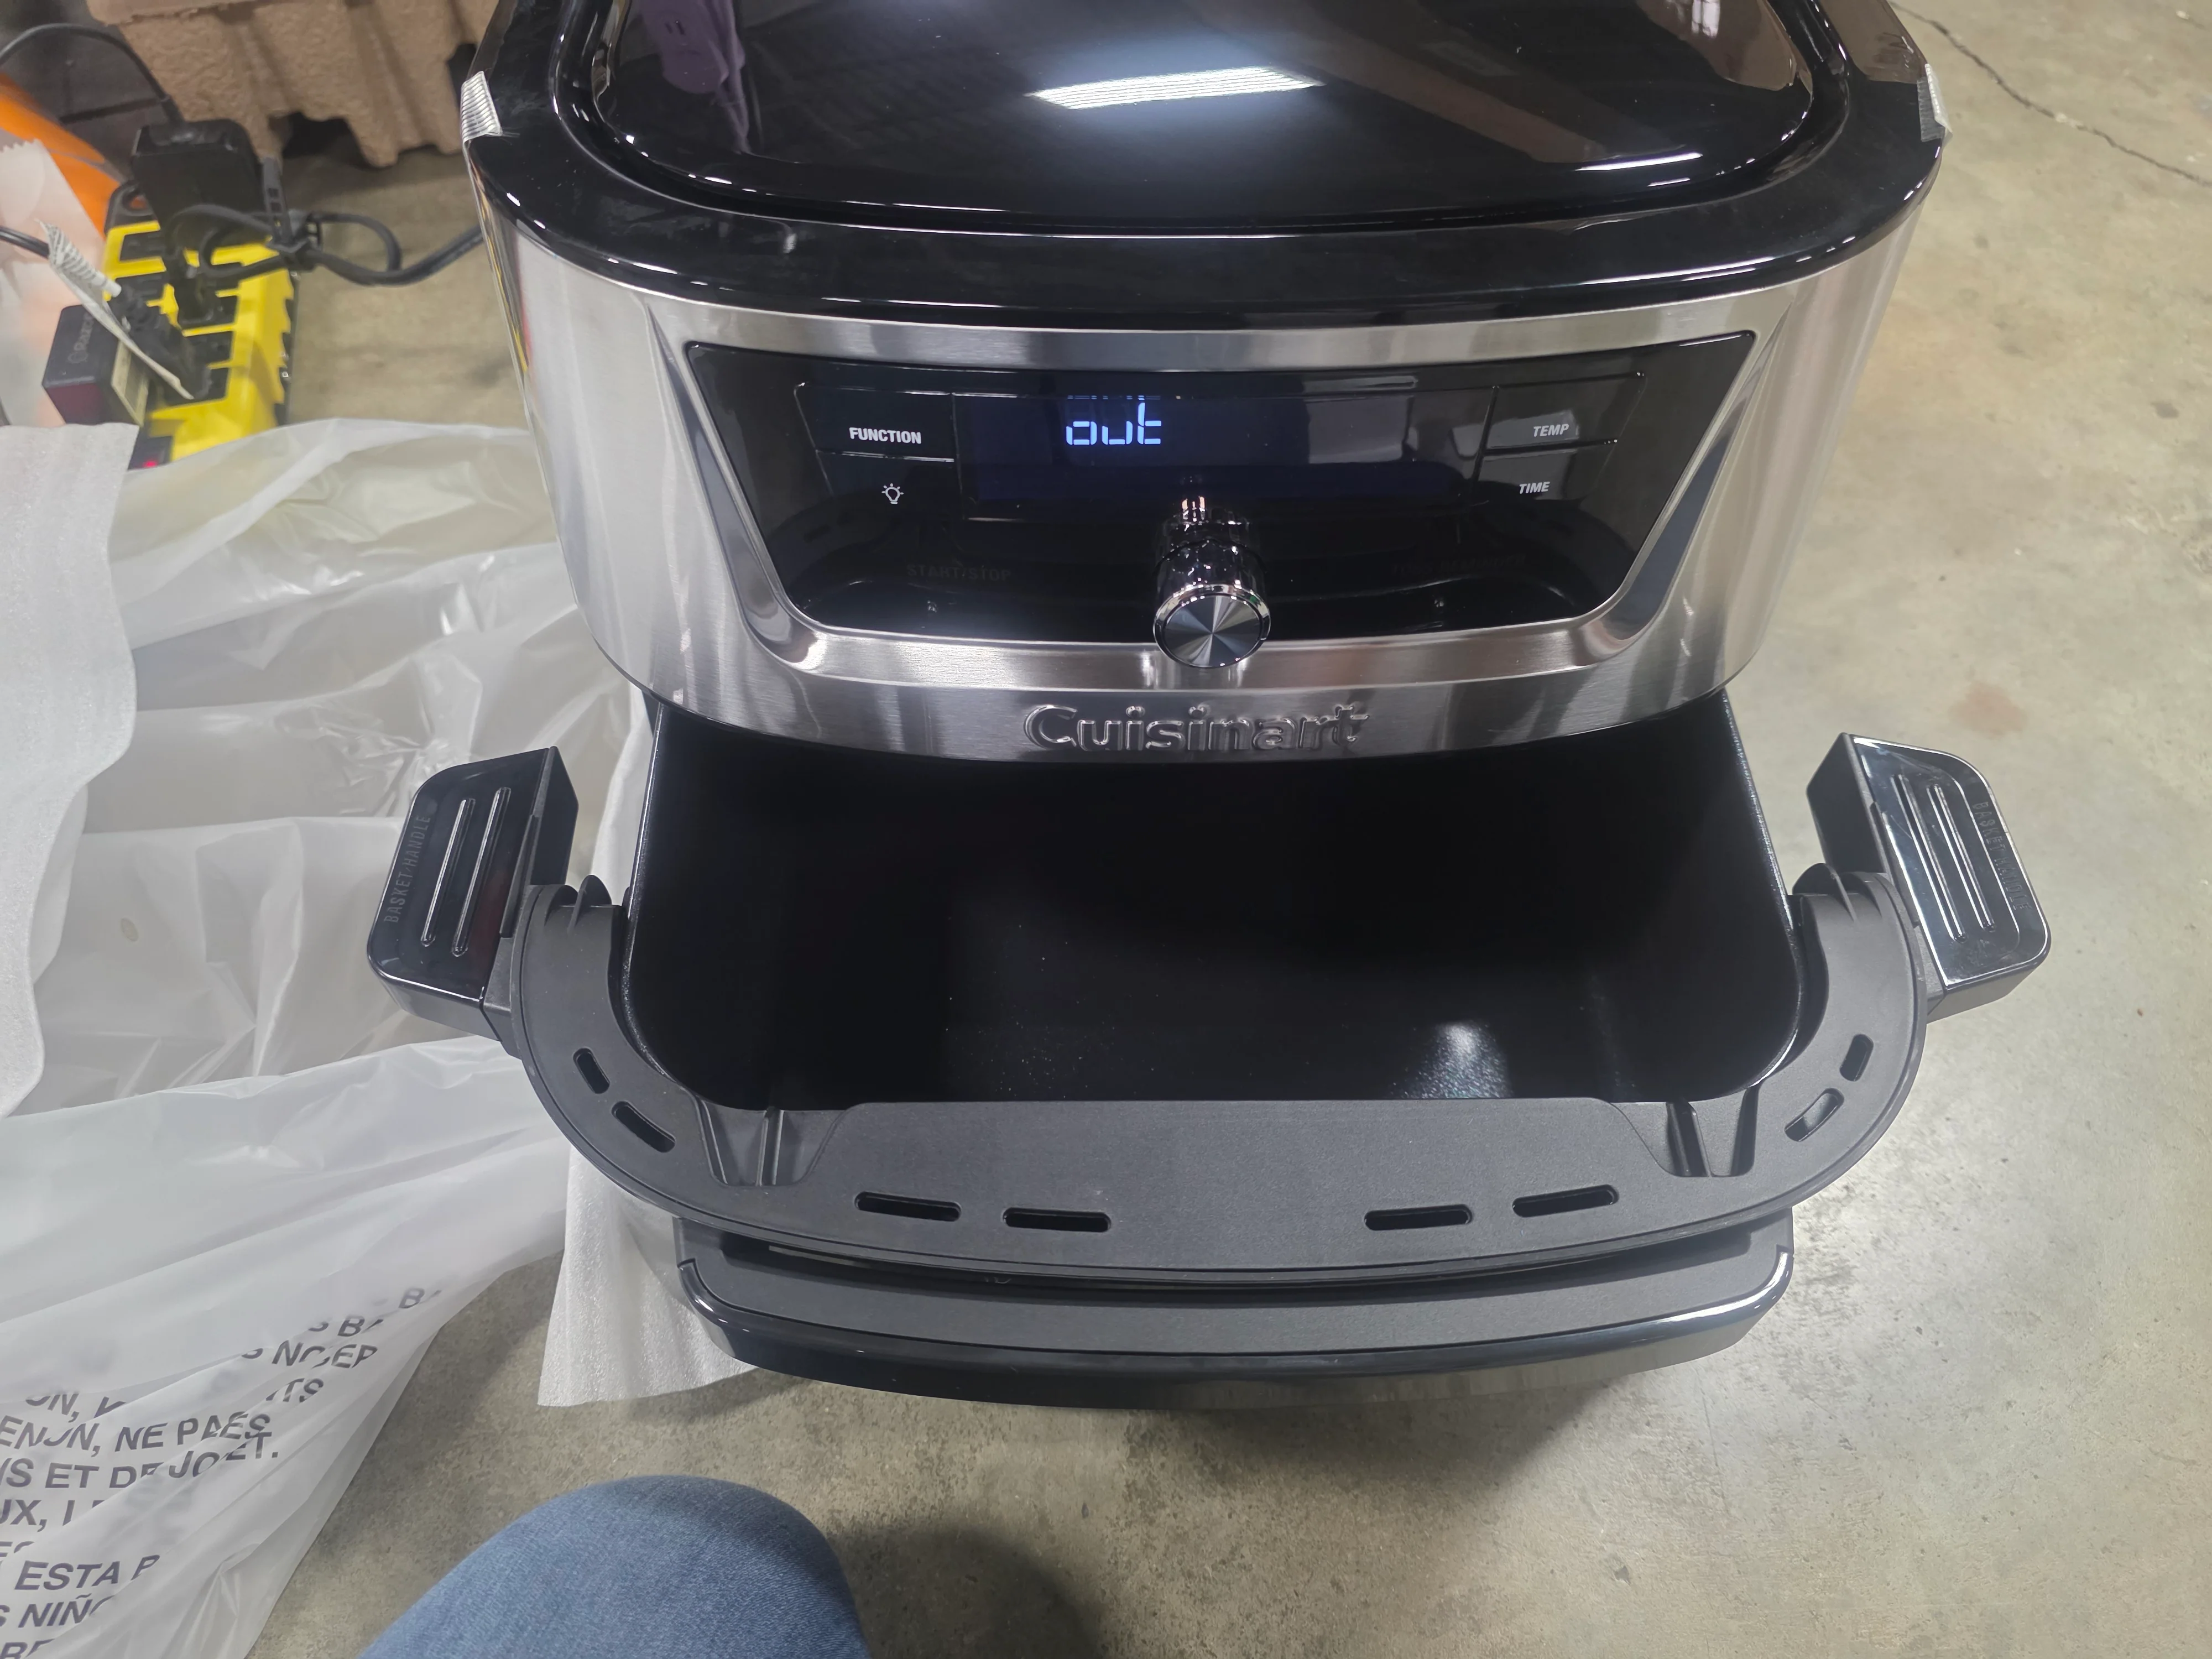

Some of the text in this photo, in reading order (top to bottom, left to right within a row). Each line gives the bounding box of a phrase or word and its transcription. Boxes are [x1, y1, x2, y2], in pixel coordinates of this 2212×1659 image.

[849, 426, 922, 445] FUNCTION
[1532, 423, 1569, 438] TEMP
[1519, 481, 1551, 495] TIME
[1023, 705, 1370, 752] Cuisinart
[1971, 801, 2007, 852] BASKET
[384, 815, 431, 923] BASKET HANDLE
[114, 1422, 168, 1452] NE
[45, 1462, 100, 1488] ET
[14, 1560, 121, 1590] ESTA
